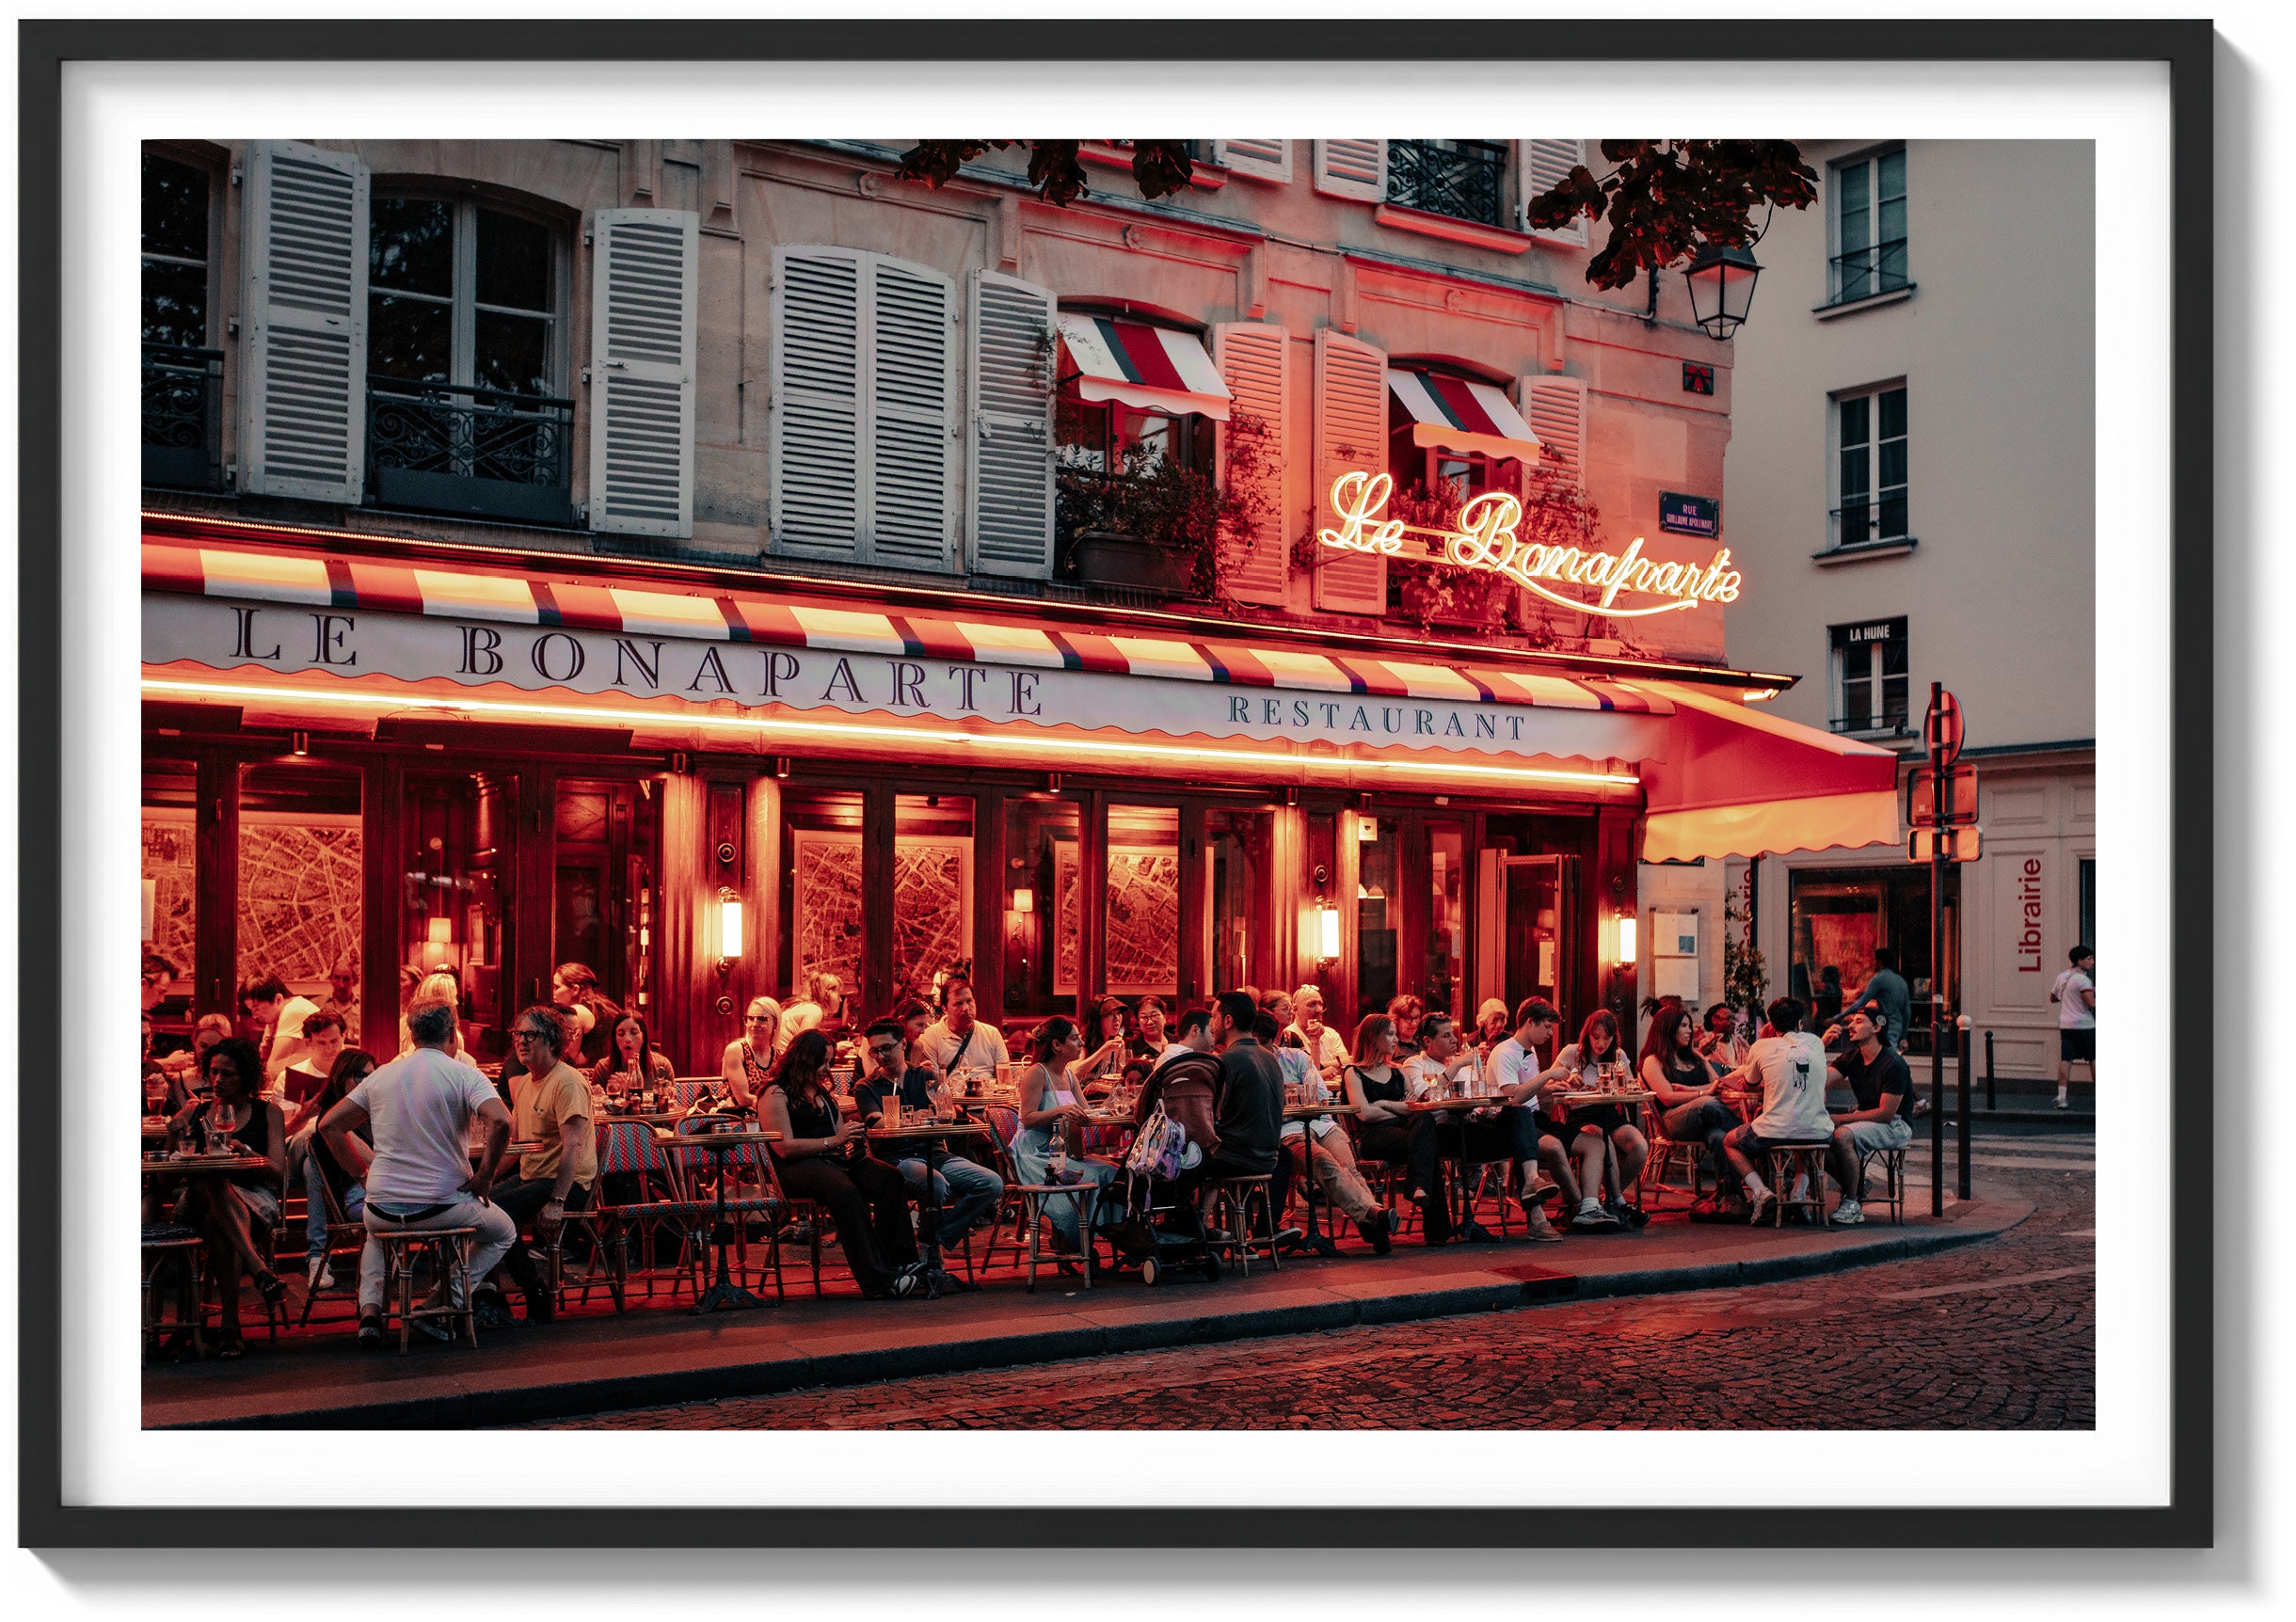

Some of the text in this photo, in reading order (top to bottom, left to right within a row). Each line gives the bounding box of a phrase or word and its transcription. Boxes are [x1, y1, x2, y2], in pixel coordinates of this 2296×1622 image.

[1317, 470, 1743, 617] Le Bonaparte
[1682, 503, 1698, 517] RUE
[229, 607, 1043, 716] LE BONAPARTE
[1849, 624, 1890, 643] LA HUNE
[1226, 694, 1525, 741] RESTAURANT
[2017, 858, 2042, 973] Librairie
